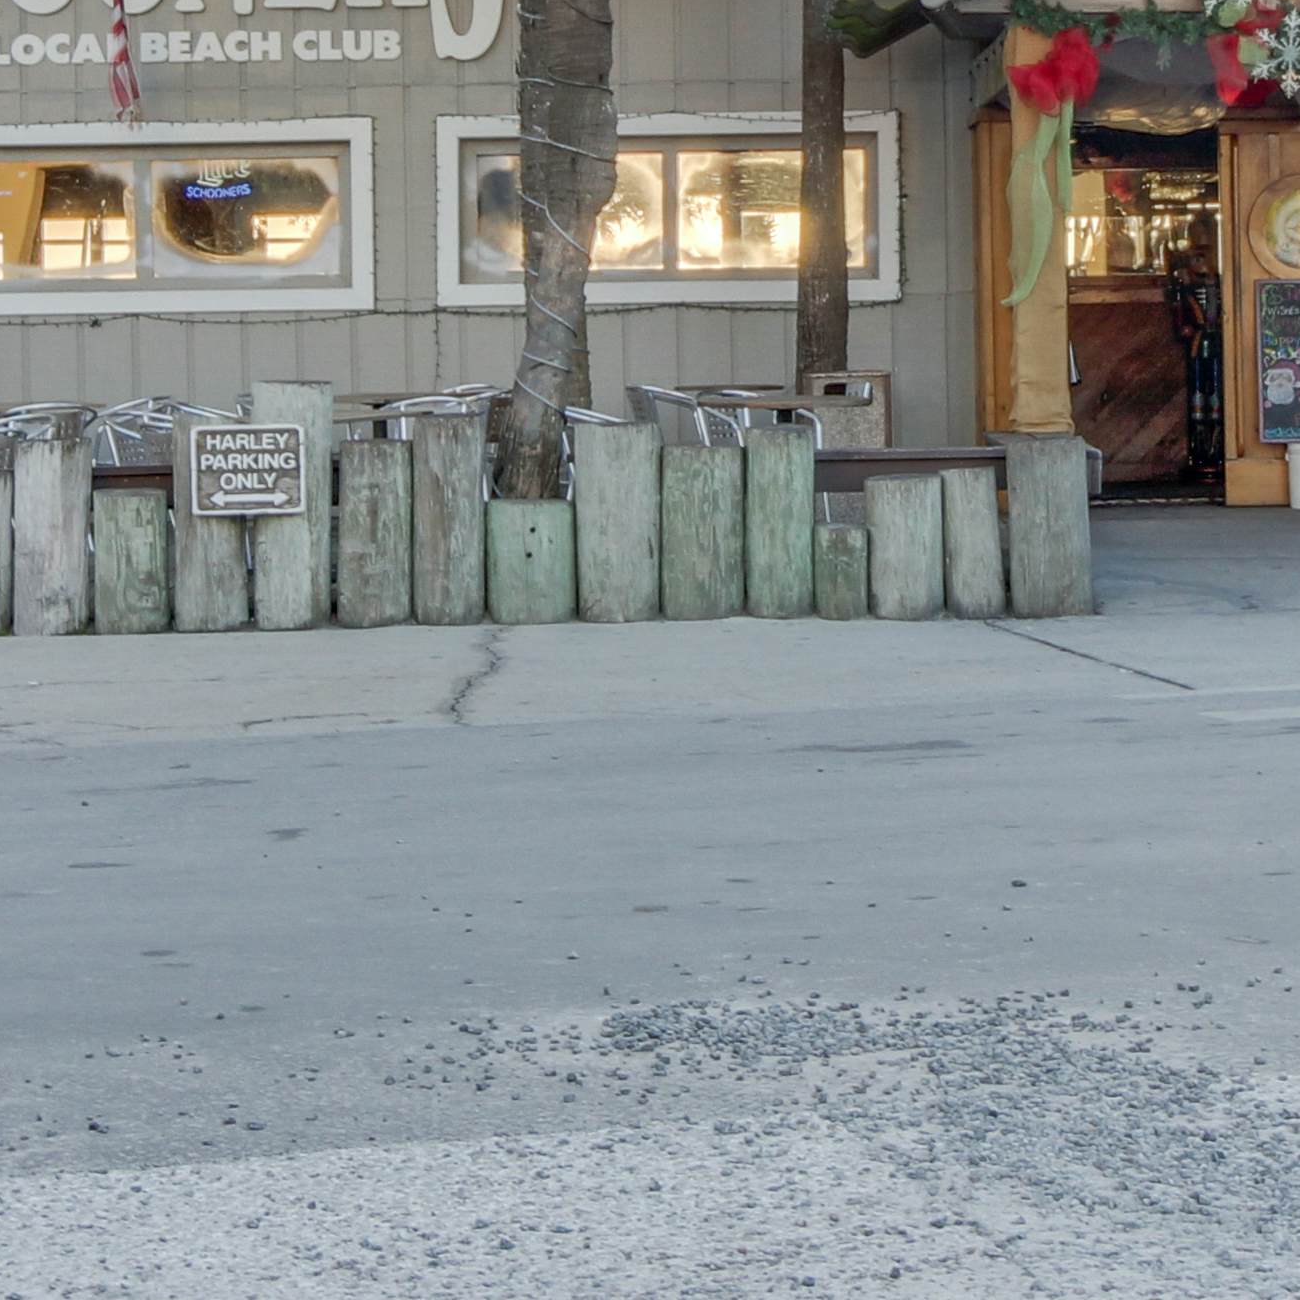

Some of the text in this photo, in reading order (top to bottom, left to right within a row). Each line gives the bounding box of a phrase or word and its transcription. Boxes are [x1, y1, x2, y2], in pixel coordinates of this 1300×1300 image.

[140, 31, 282, 63] BEACH
[293, 29, 402, 61] CLUB
[186, 184, 252, 198] SCHOONERS
[206, 433, 289, 450] HARLEY
[200, 453, 297, 470] PARKING
[220, 473, 277, 490] ONLY
